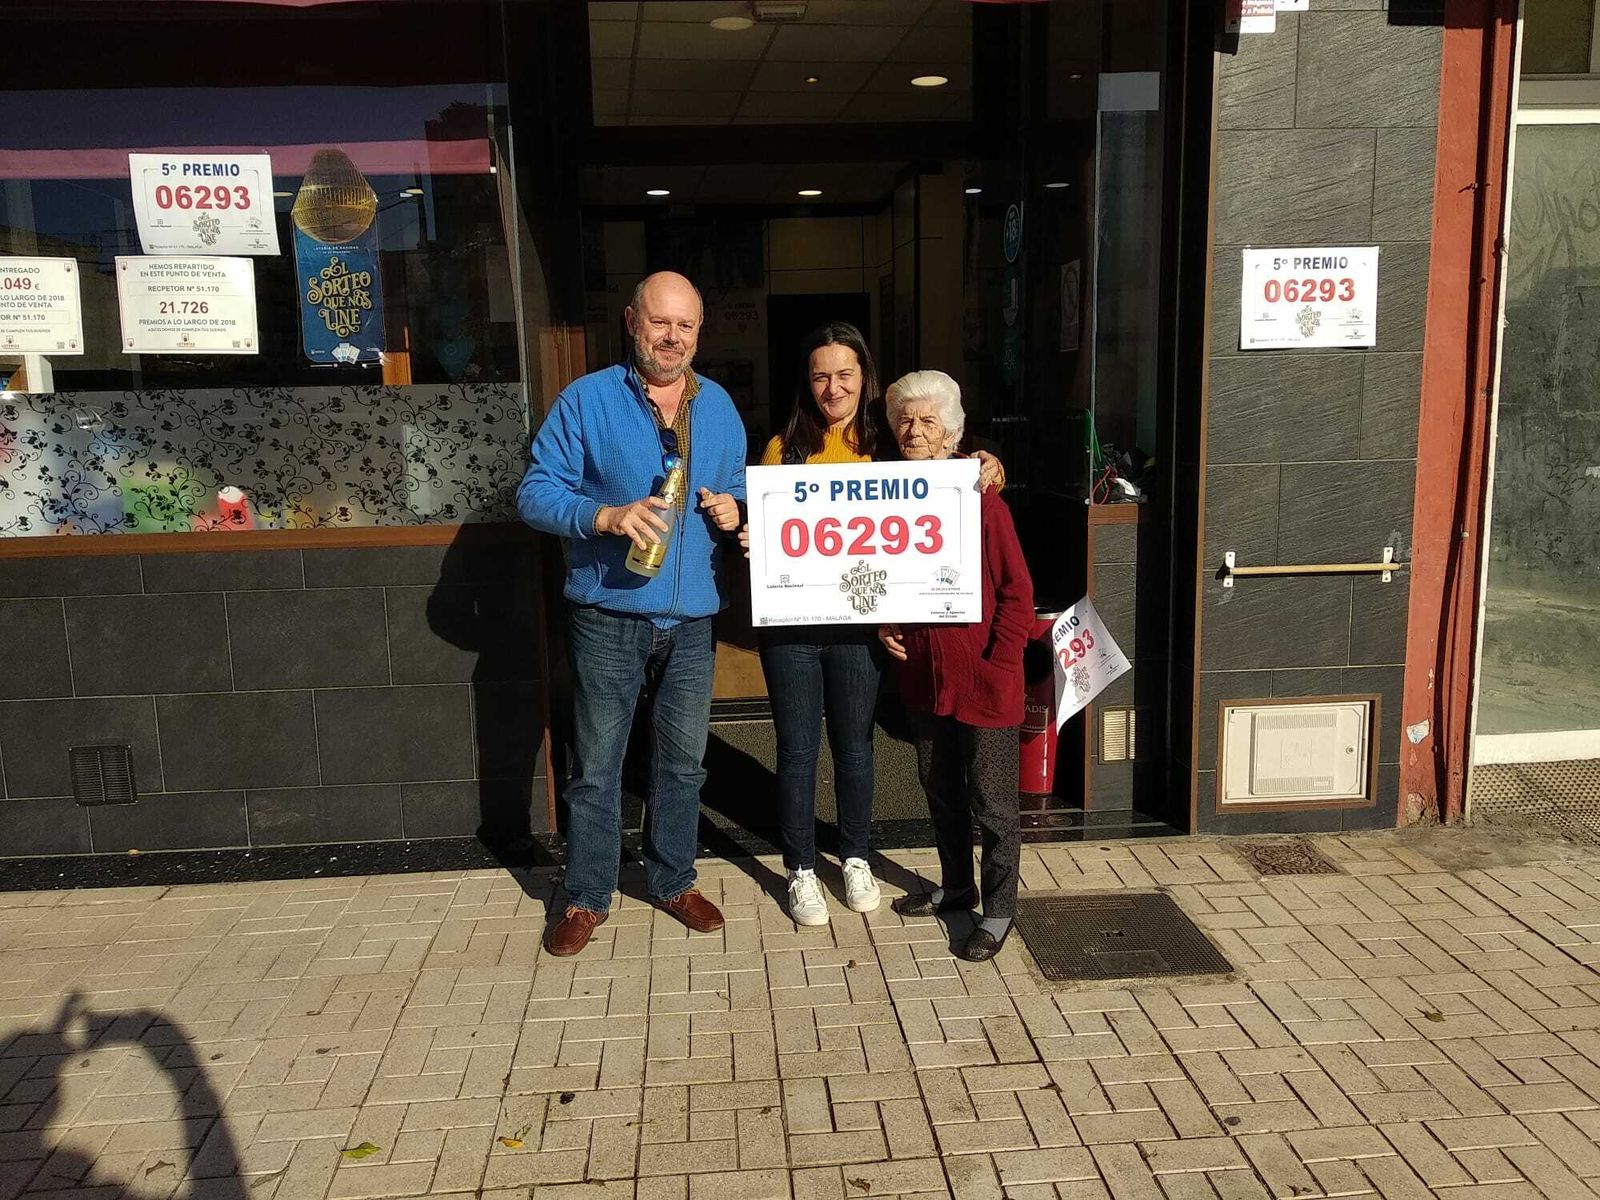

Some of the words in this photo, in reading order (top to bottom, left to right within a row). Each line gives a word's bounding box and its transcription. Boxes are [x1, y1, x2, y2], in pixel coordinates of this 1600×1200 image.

[162, 163, 177, 176] 5º
[183, 163, 240, 176] PREMIO
[155, 185, 251, 210] 06293
[320, 257, 348, 279] EL
[1273, 257, 1288, 270] 5º
[1293, 256, 1348, 269] PREMIO
[307, 271, 371, 304] SORTEO
[1264, 278, 1355, 302] 06293
[159, 301, 209, 314] 21.726
[323, 296, 346, 310] QUE
[348, 289, 372, 309] NOS
[318, 308, 361, 337] UNE
[794, 481, 820, 503] 5º
[830, 478, 929, 501] PREMIO
[780, 514, 943, 557] 06293
[850, 560, 871, 575] EL
[839, 570, 887, 592] SORTEO
[851, 586, 868, 597] QUE
[870, 582, 887, 596] NOS
[847, 595, 878, 615] UNE
[1054, 616, 1080, 644] EMIO
[1023, 704, 1047, 713] ADIS
